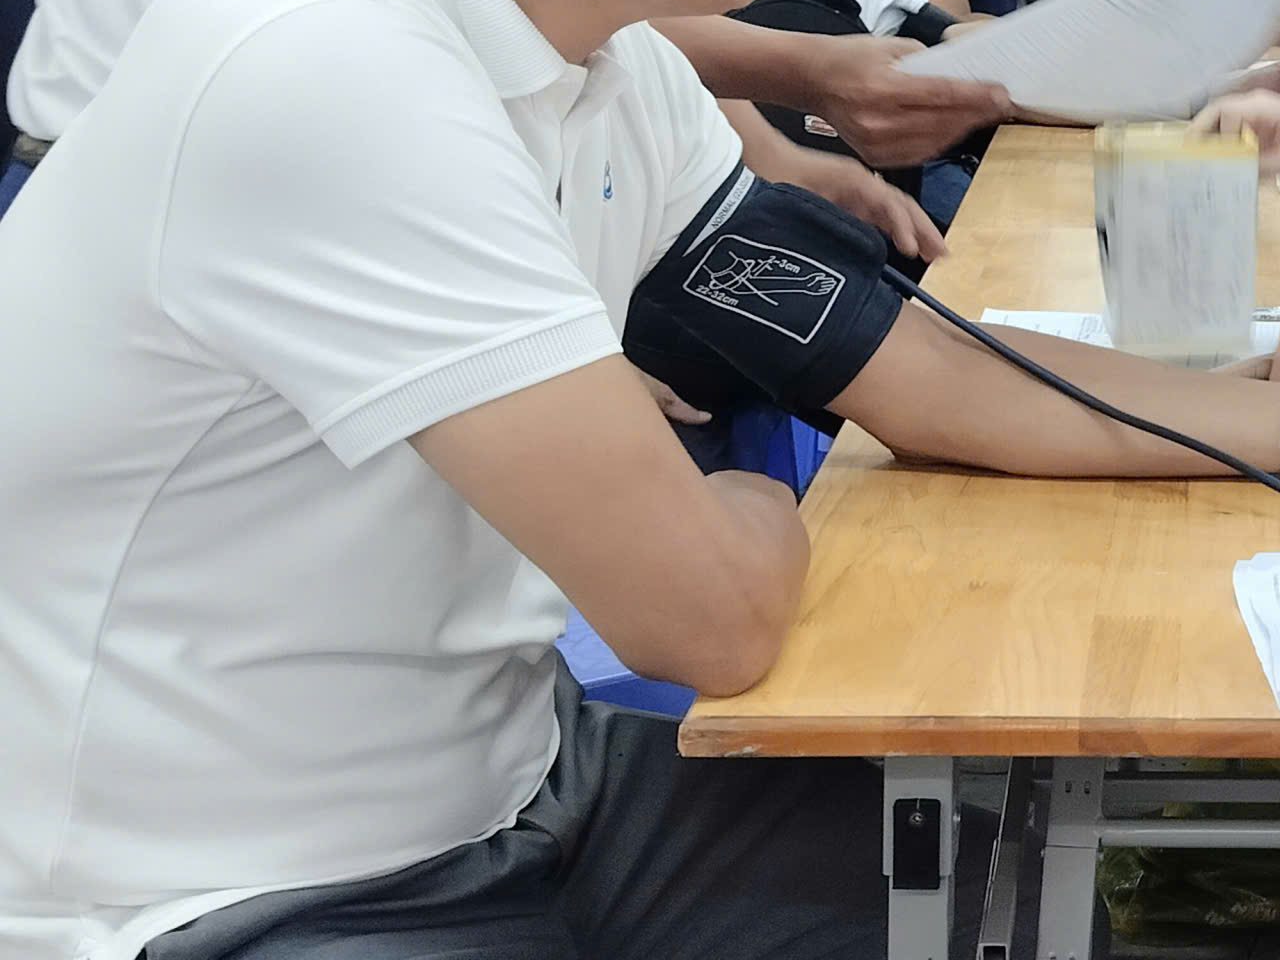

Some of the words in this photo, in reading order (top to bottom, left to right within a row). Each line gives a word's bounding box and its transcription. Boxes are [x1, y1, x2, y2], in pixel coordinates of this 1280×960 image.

[711, 200, 736, 229] NORMAL
[768, 255, 801, 274] 2-3cm
[696, 285, 739, 306] 22-32cm
